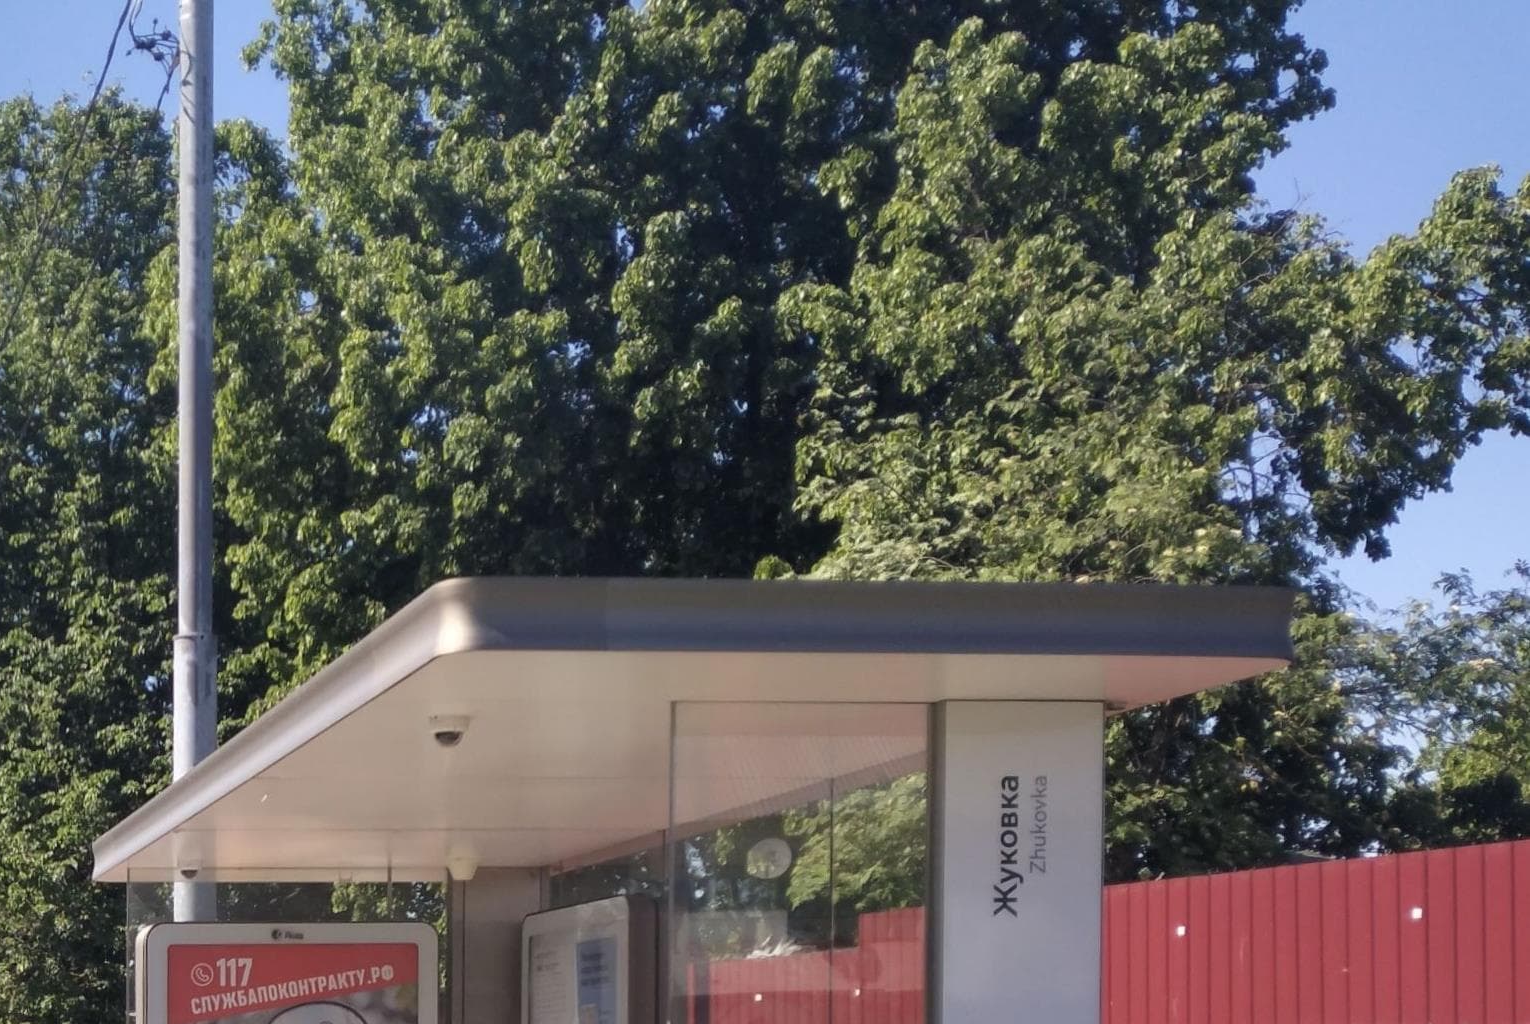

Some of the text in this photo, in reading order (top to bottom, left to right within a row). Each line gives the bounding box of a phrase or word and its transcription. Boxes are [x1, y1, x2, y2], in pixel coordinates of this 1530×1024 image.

[993, 775, 1023, 918] Жуковка
[1029, 775, 1048, 874] Zhukovka
[191, 964, 394, 1015] СЛУЖБАПОКОНТРАКТУ.РФ
[216, 958, 253, 987] 117
